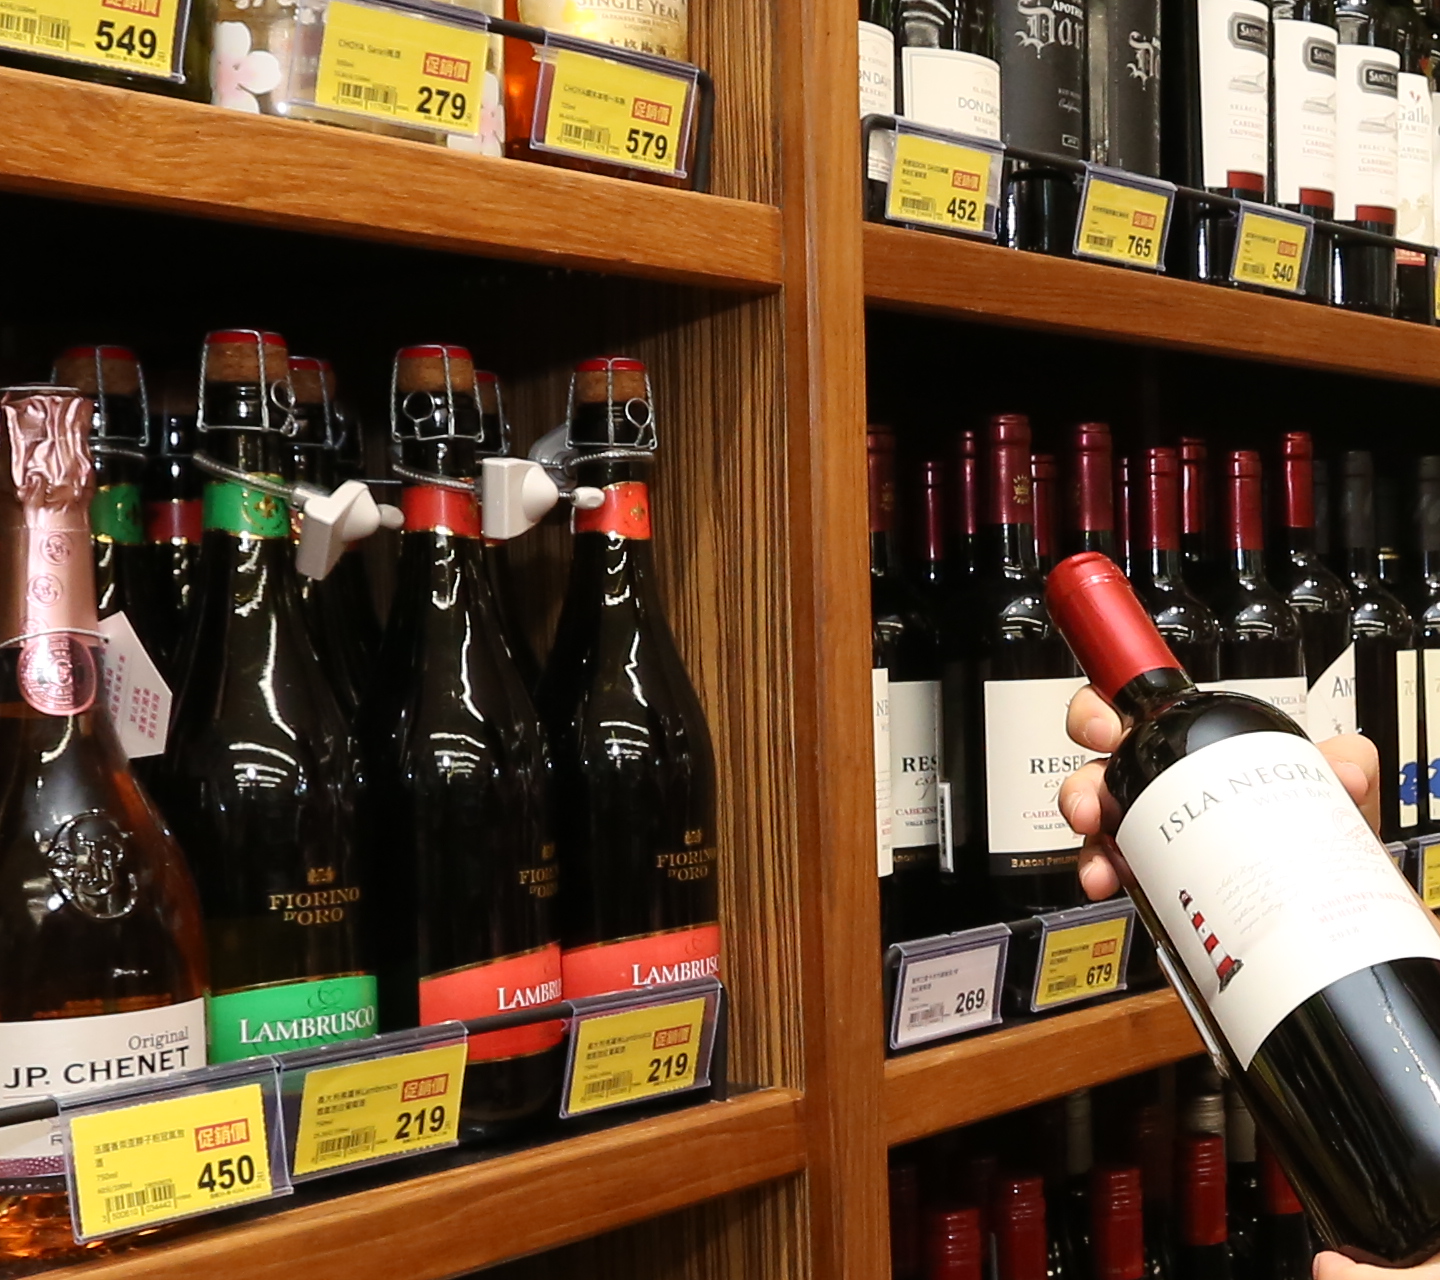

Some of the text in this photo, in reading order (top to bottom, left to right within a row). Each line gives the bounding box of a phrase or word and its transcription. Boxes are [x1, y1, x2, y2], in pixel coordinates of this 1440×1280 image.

[650, 0, 679, 20] YEAR
[94, 19, 158, 59] 549
[416, 86, 466, 120] 279
[626, 127, 668, 159] 579
[946, 197, 977, 222] 452
[1127, 235, 1152, 258] 765
[1272, 263, 1294, 283] 540
[1158, 762, 1330, 845] ISLA NEGRA
[1252, 786, 1332, 808] WEST BAY
[269, 886, 360, 910] FIORINO
[1085, 963, 1112, 986] 679
[954, 988, 985, 1015] 269
[238, 1004, 375, 1045] LAMBRUSCO
[127, 1025, 189, 1054] Original
[3, 1045, 190, 1089] JP. CHENET
[647, 1052, 688, 1083] 219
[197, 1121, 248, 1150] 促銷價
[394, 1105, 445, 1140] 219
[197, 1155, 255, 1193] 450
